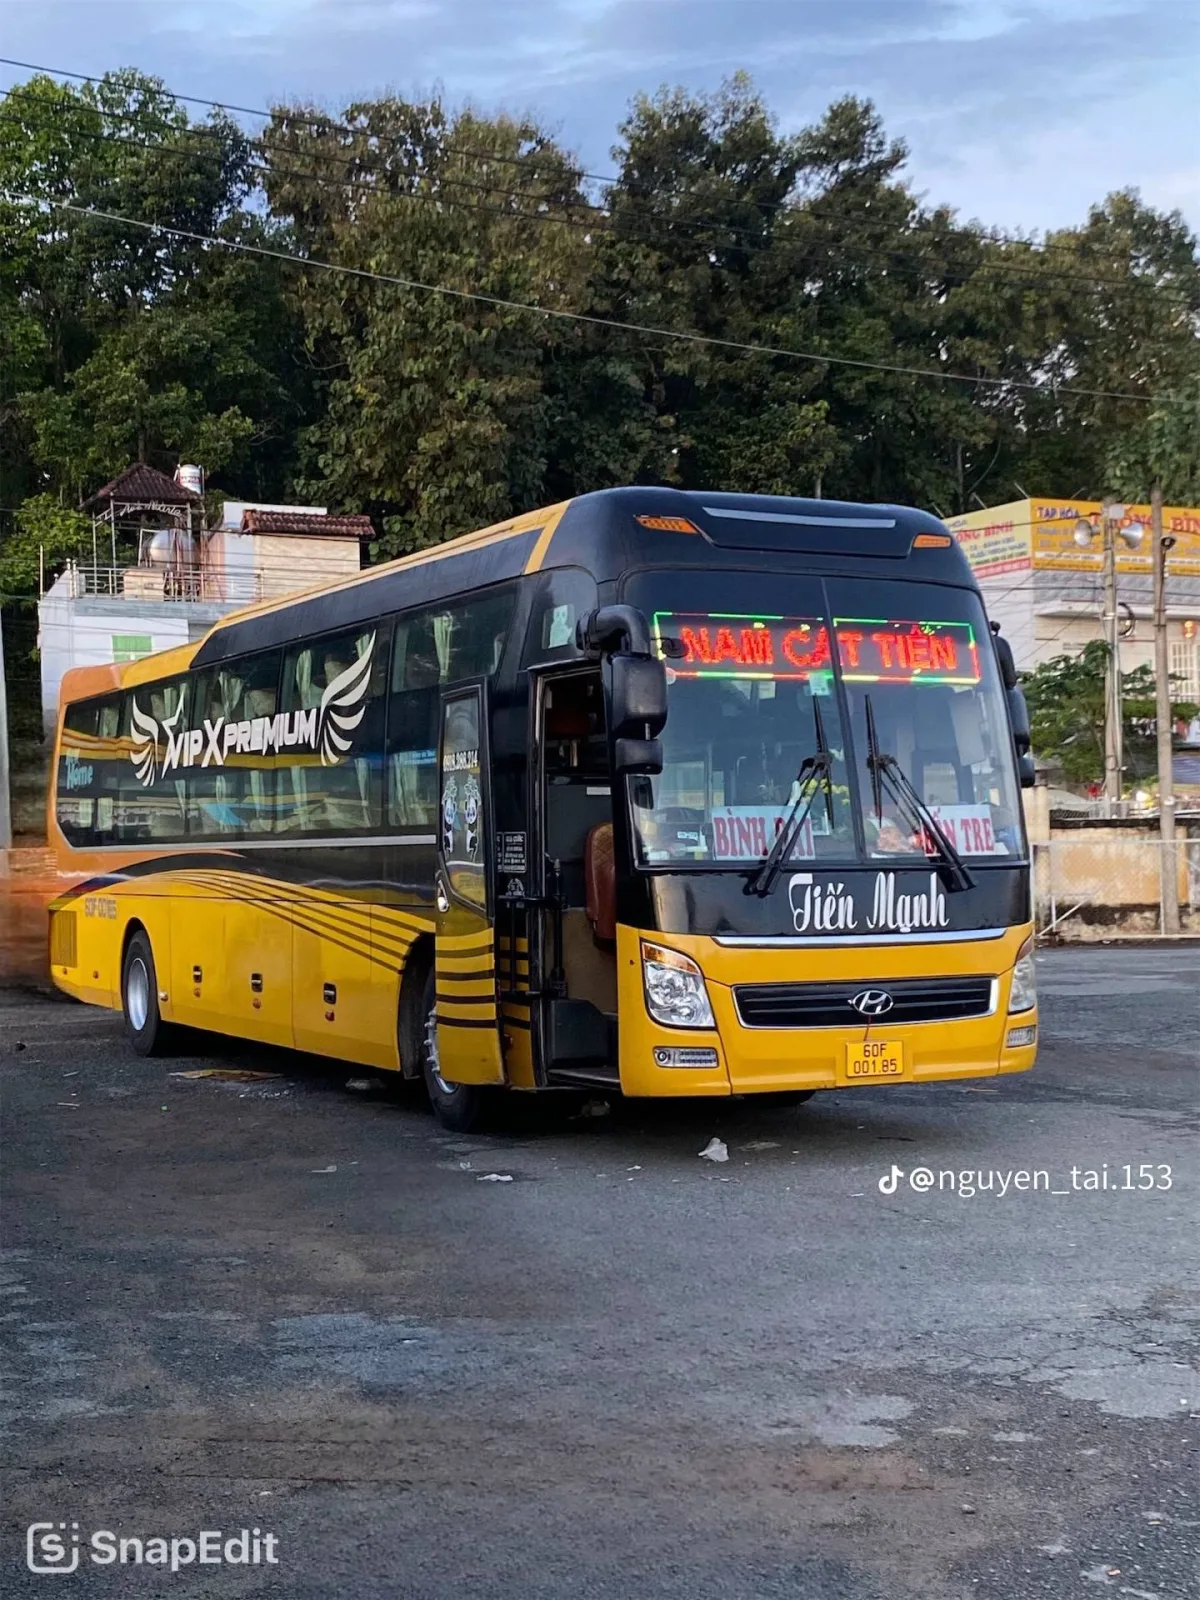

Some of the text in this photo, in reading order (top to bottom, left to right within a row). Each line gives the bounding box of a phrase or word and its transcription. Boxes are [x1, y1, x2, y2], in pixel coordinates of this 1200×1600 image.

[681, 627, 773, 666] NAM
[713, 807, 769, 857] BÌNH
[960, 817, 995, 853] TRE
[789, 871, 950, 933] Tiến Mạnh
[853, 1058, 898, 1075] 001.85
[863, 1043, 888, 1058] 60F
